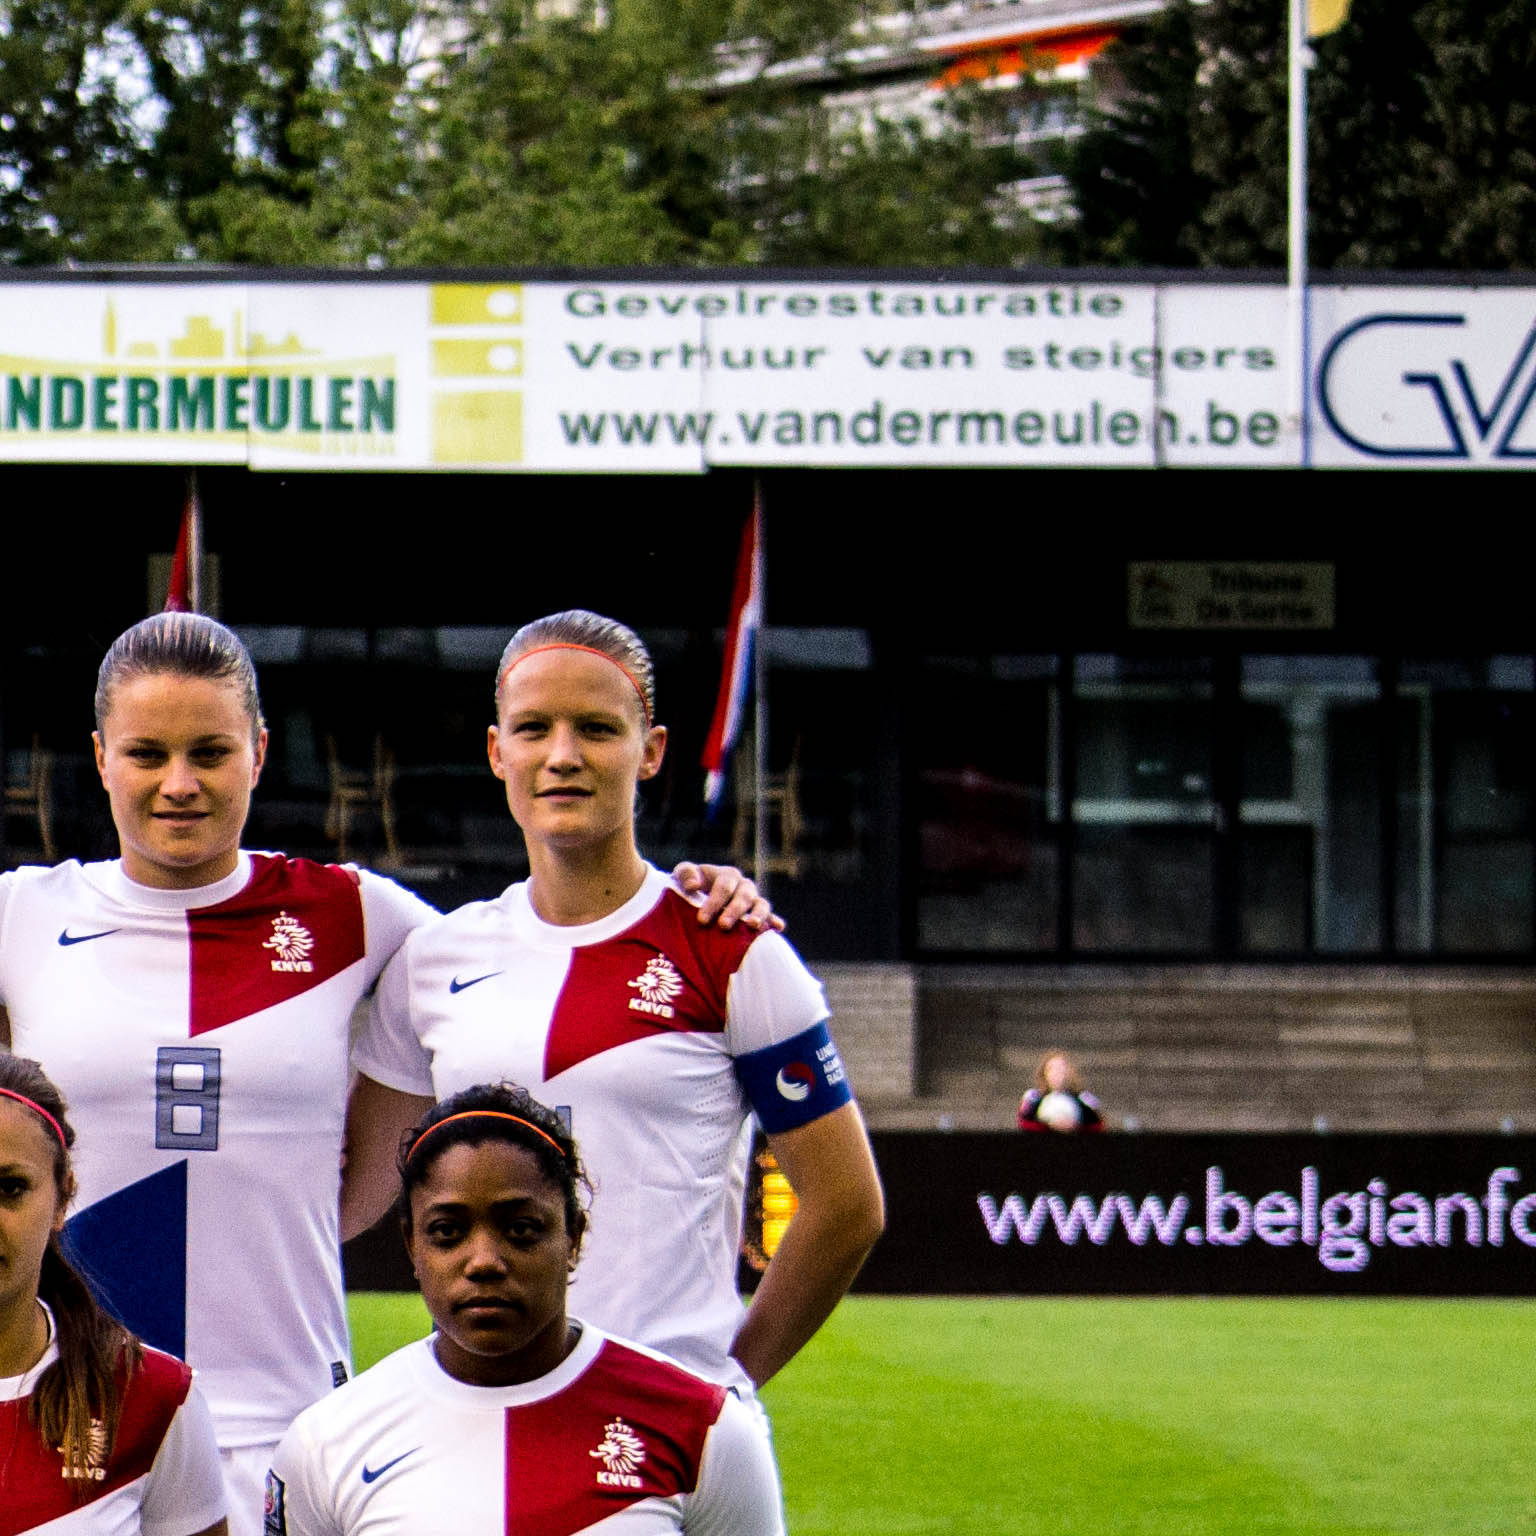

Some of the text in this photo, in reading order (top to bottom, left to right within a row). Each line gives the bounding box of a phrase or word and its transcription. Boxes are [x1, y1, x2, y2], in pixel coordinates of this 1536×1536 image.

[564, 287, 1123, 317] Gevelrestauratie
[565, 341, 1276, 378] Verhuur van steigers
[559, 400, 1280, 446] www.vandermeulen.be
[271, 959, 314, 974] KNVB
[628, 997, 676, 1019] KNVB
[155, 1046, 222, 1152] 8
[596, 1471, 643, 1489] KNVB
